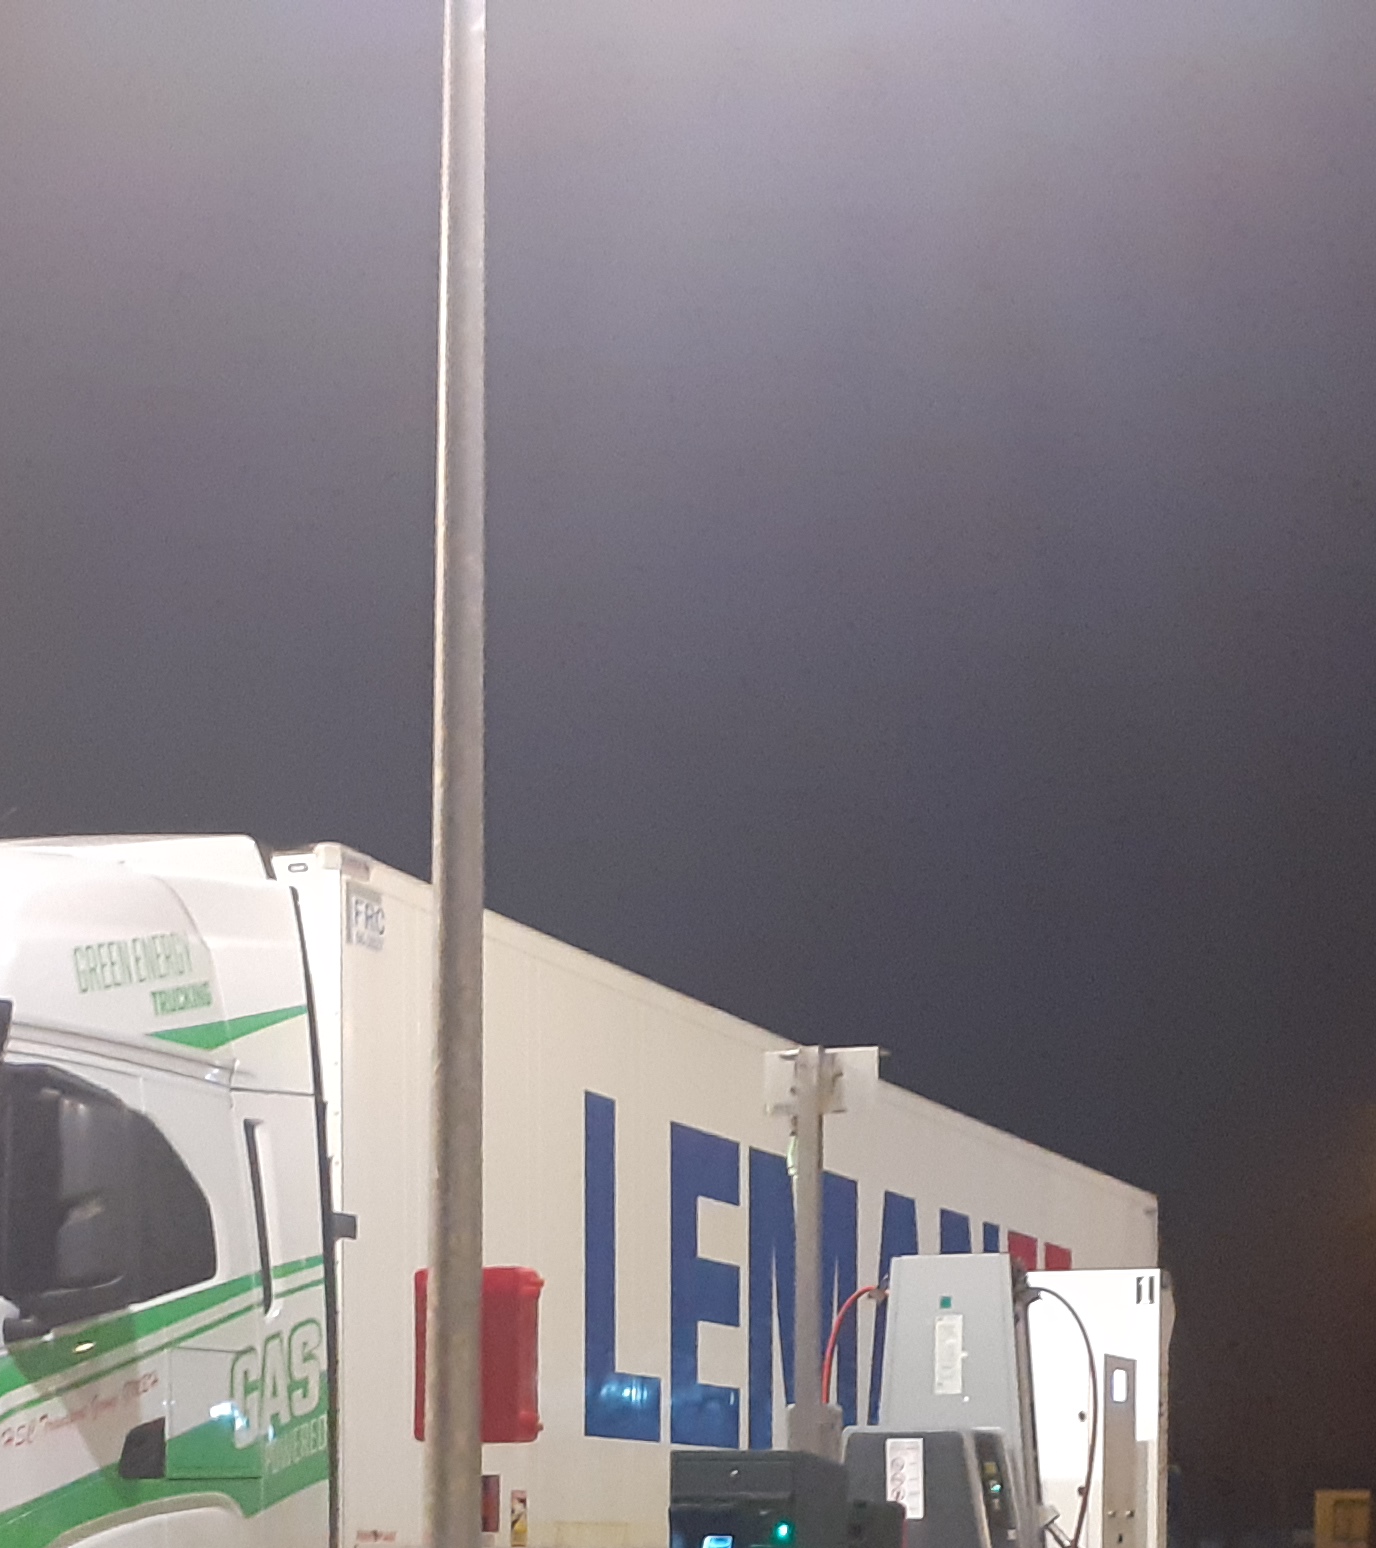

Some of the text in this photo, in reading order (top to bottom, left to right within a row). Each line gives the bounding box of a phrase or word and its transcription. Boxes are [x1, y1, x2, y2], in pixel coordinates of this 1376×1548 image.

[73, 931, 192, 994] GREEN ENERGY
[584, 1090, 999, 1449] LEMA
[230, 1318, 323, 1449] GAS
